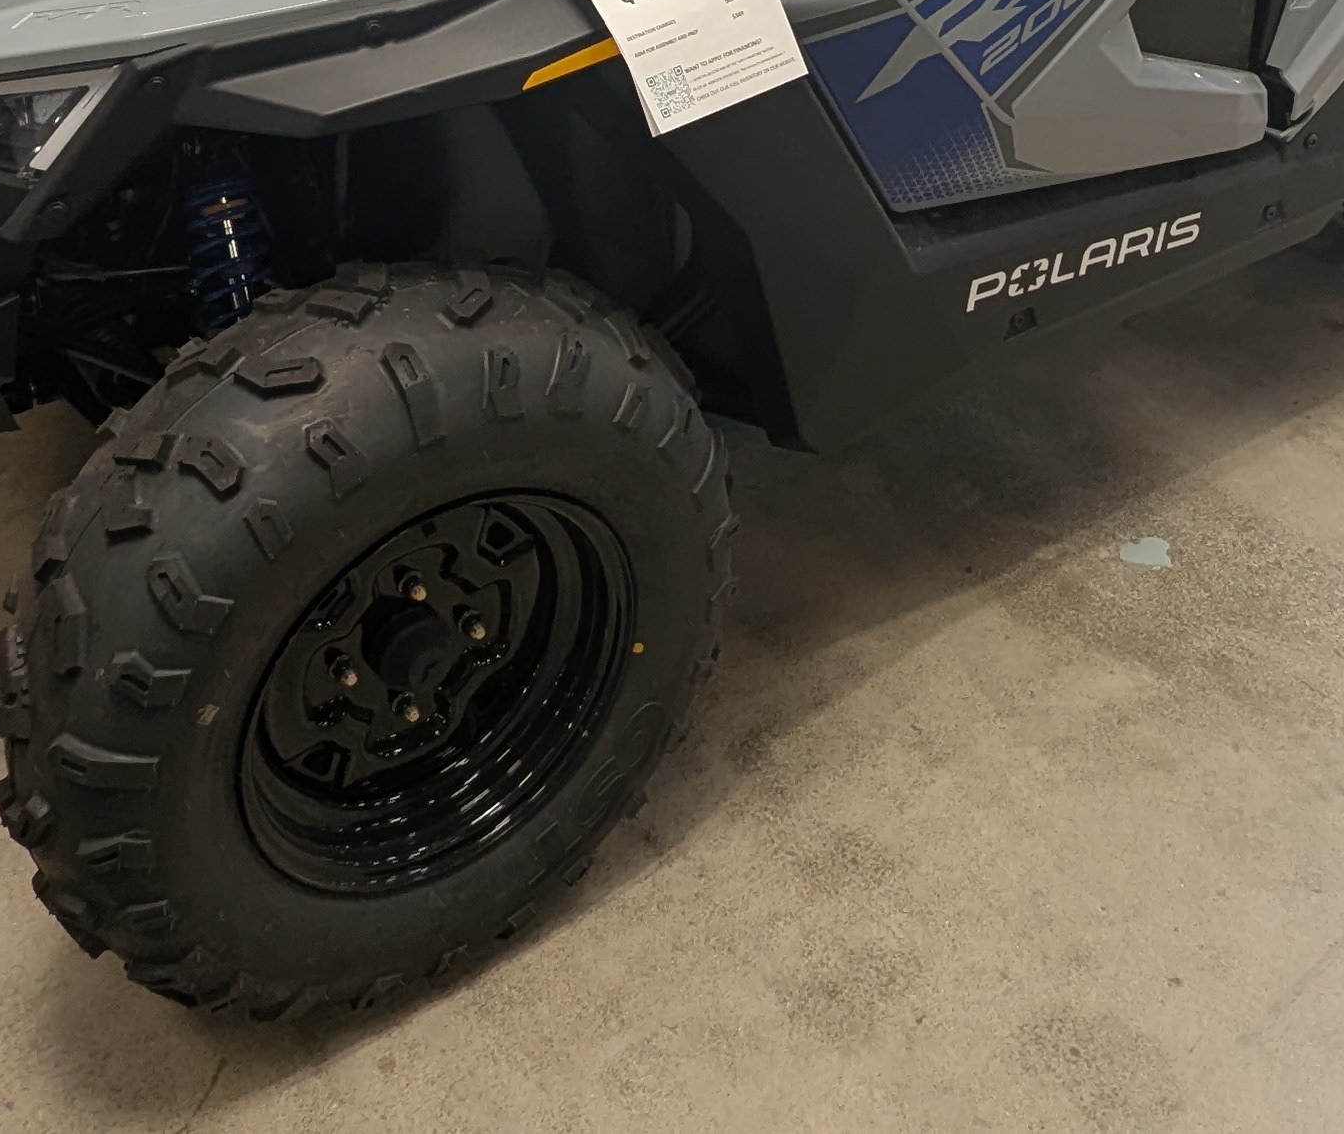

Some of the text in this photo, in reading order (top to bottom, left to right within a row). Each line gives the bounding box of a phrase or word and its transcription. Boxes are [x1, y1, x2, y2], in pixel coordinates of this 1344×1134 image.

[684, 63, 700, 74] WANT
[723, 49, 734, 59] FOR
[965, 212, 1202, 313] POLARIS
